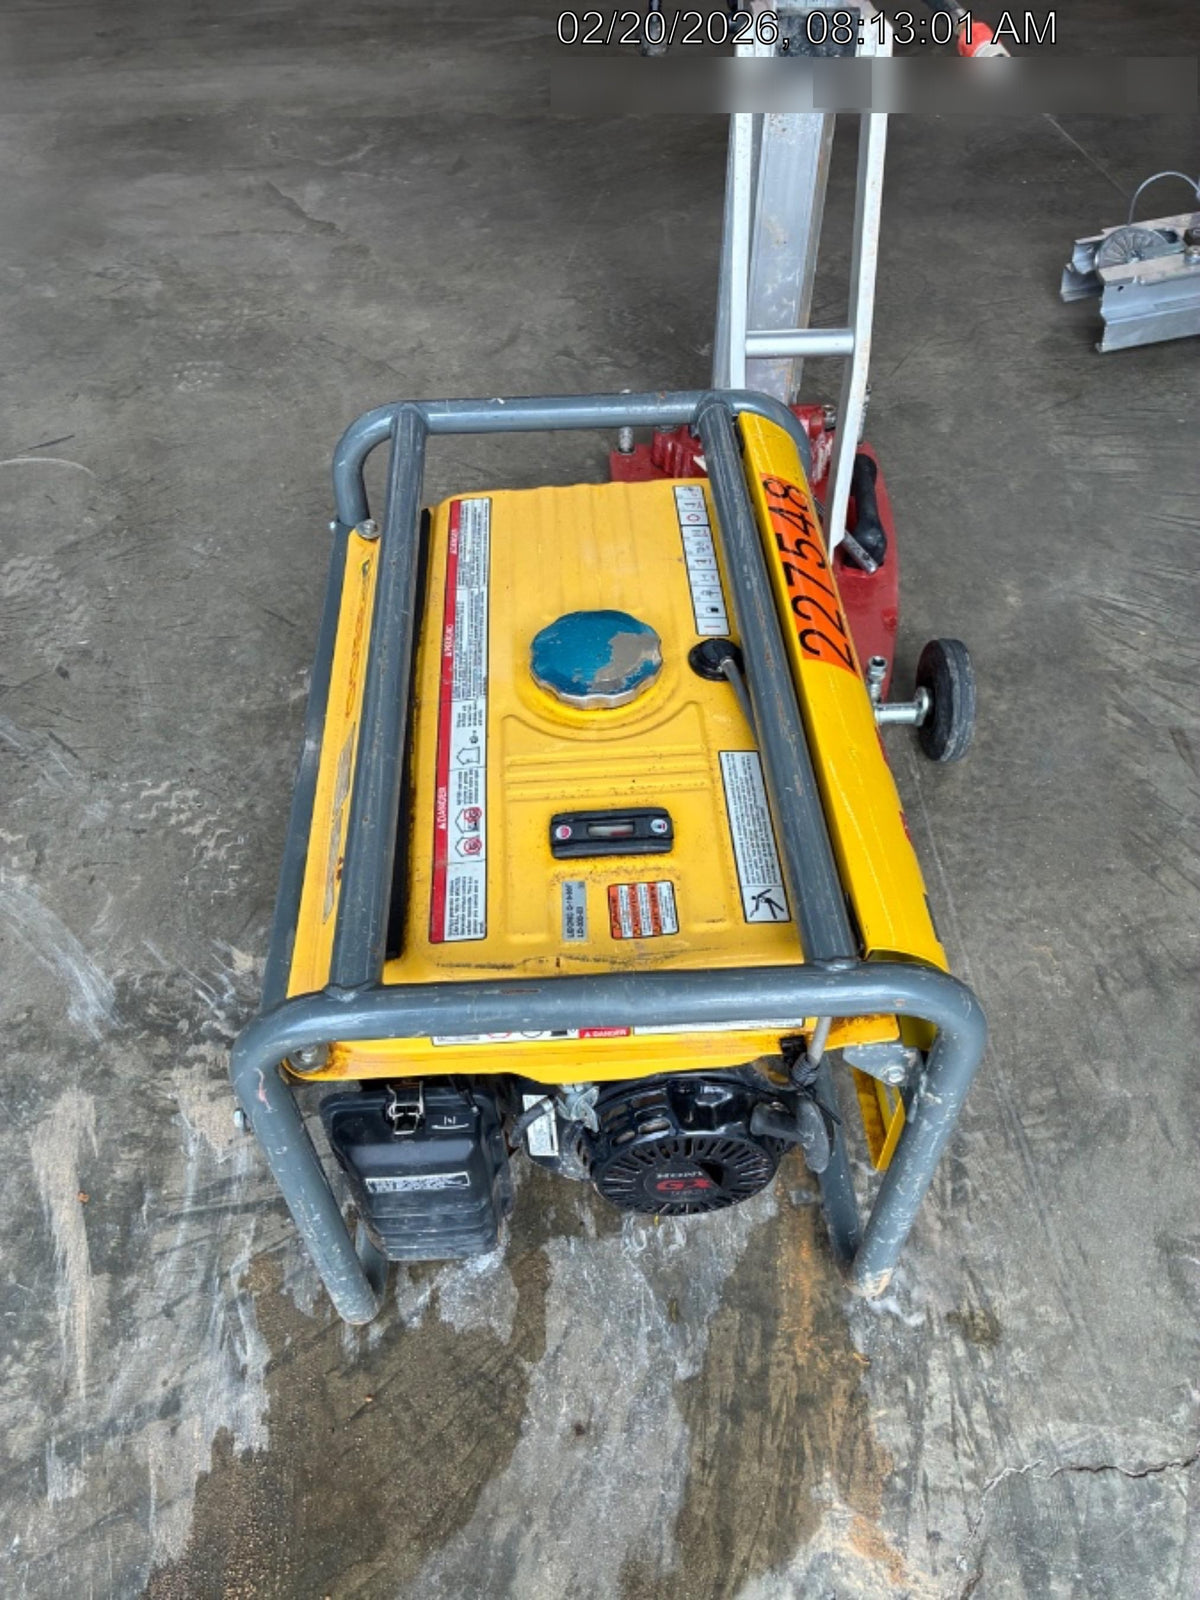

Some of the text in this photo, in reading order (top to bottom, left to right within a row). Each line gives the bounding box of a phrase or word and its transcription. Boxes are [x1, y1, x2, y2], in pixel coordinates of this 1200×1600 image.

[762, 477, 857, 674] 227548
[436, 787, 447, 822] DANGER
[656, 1170, 704, 1179] HON
[656, 1177, 710, 1192] GX
